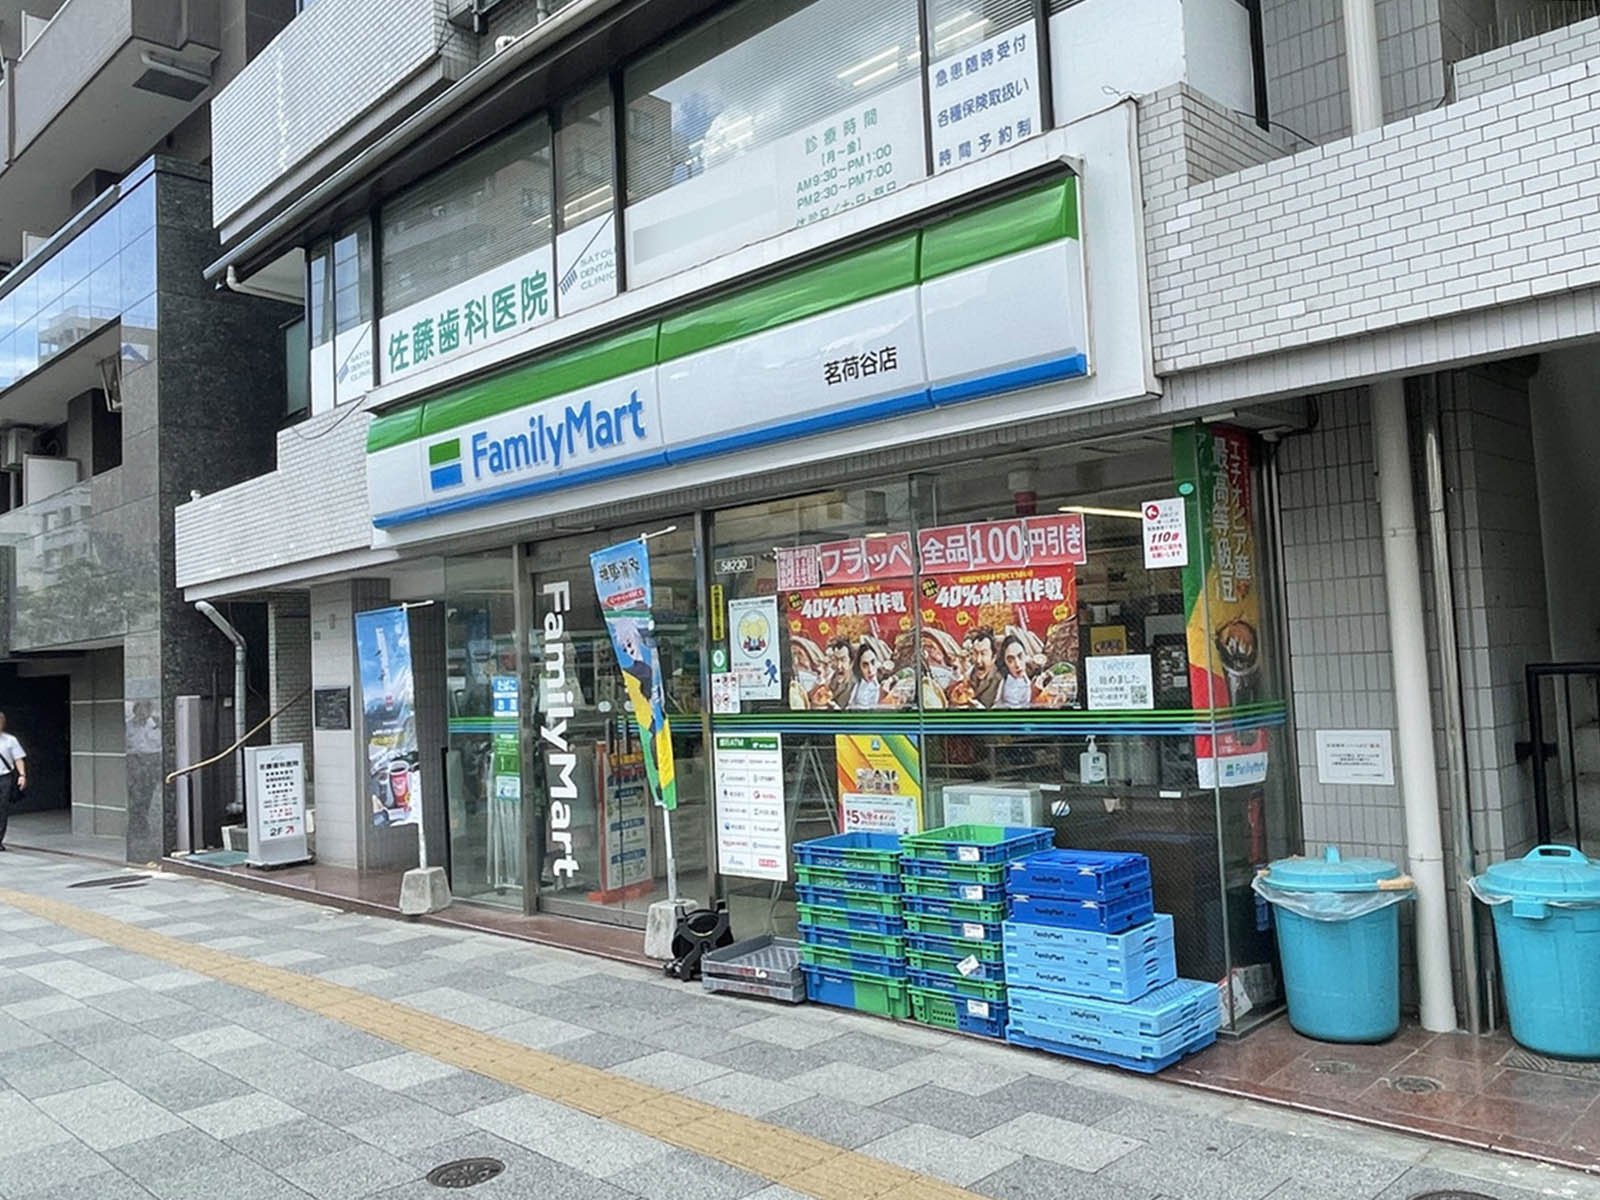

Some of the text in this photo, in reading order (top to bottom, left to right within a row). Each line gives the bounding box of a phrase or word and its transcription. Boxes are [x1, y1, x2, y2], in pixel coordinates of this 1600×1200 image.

[388, 269, 549, 374] 佐藤歯科医院
[823, 346, 898, 386] 茗荷谷店
[472, 390, 647, 479] FamilyMart
[821, 541, 912, 577] フラッペ
[922, 523, 1082, 566] 全品100円引き
[540, 580, 581, 879] FamilyMart
